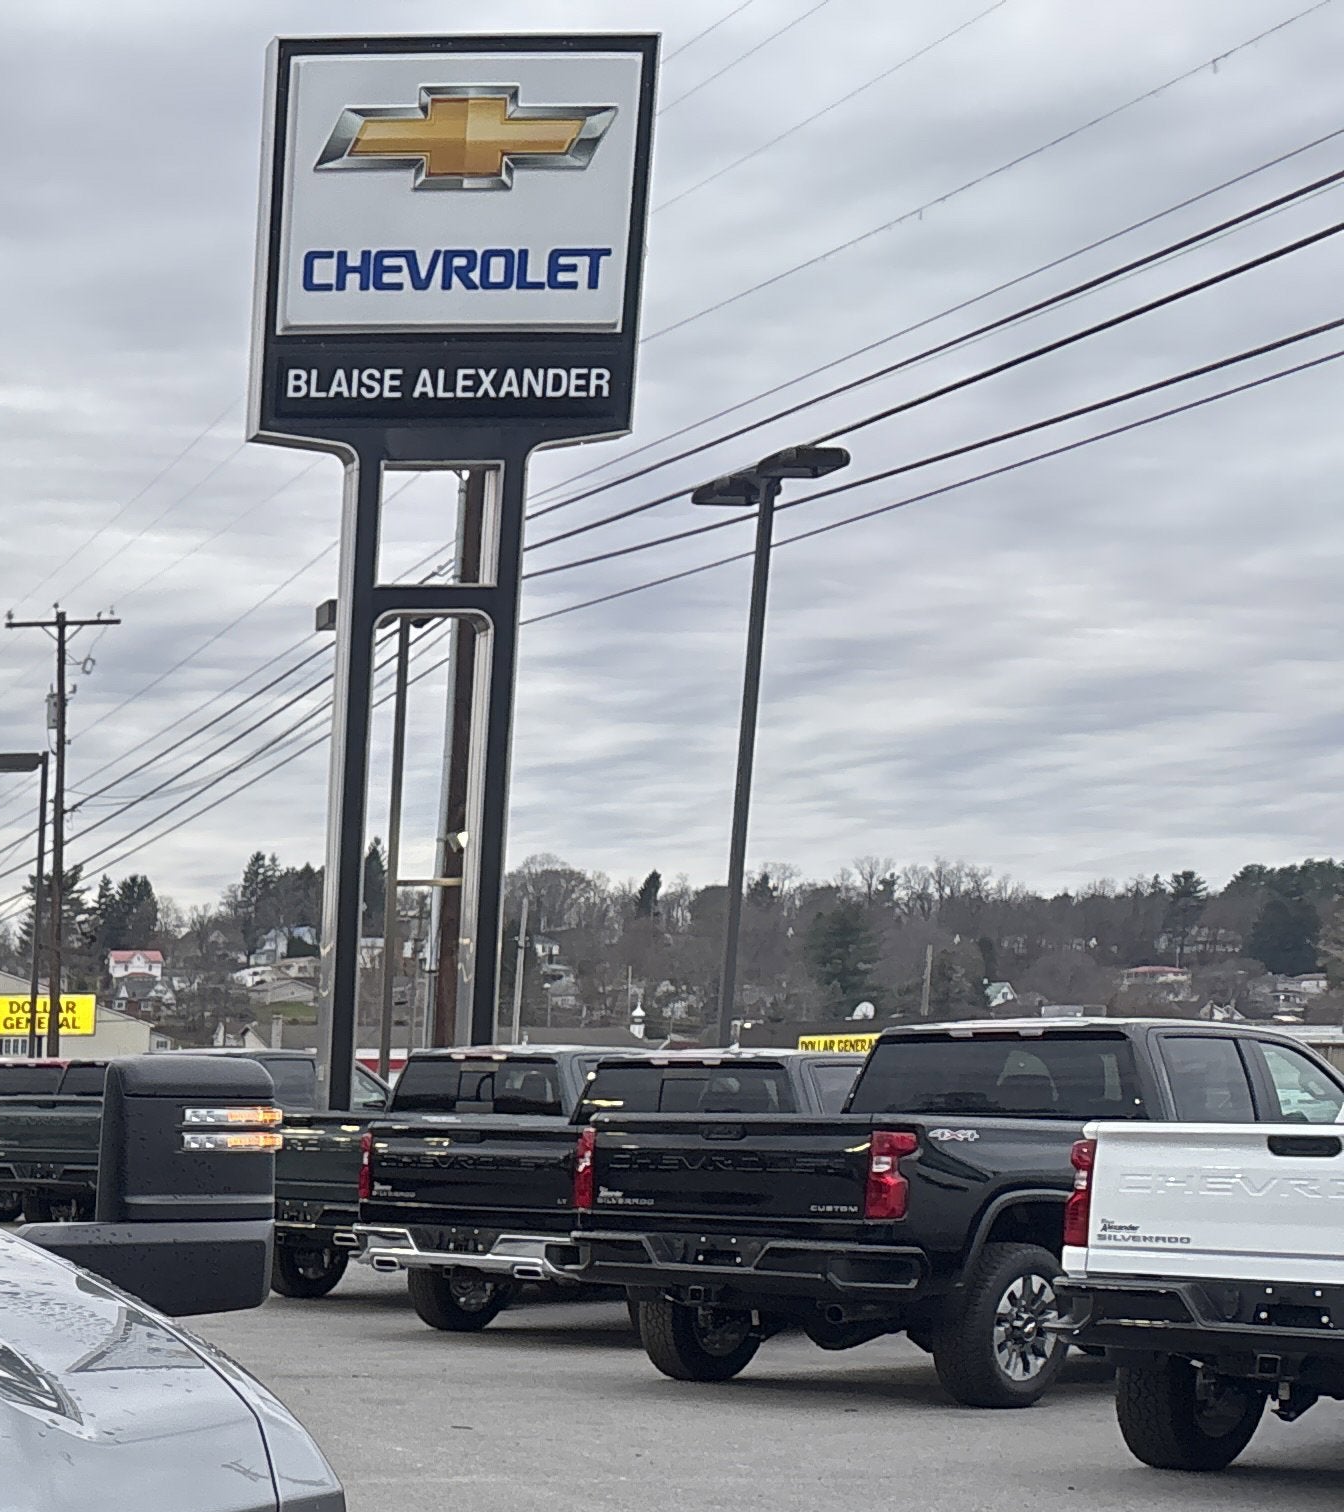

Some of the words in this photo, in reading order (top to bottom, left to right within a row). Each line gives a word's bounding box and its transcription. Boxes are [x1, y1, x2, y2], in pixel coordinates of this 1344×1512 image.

[302, 247, 612, 292] CHEVROLET
[286, 368, 403, 399] BLAISE
[412, 367, 611, 399] ALEXANDER
[837, 1038, 878, 1053] GENERA
[810, 1204, 859, 1213] CUSTOM
[1096, 1233, 1192, 1245] SILVERADO
